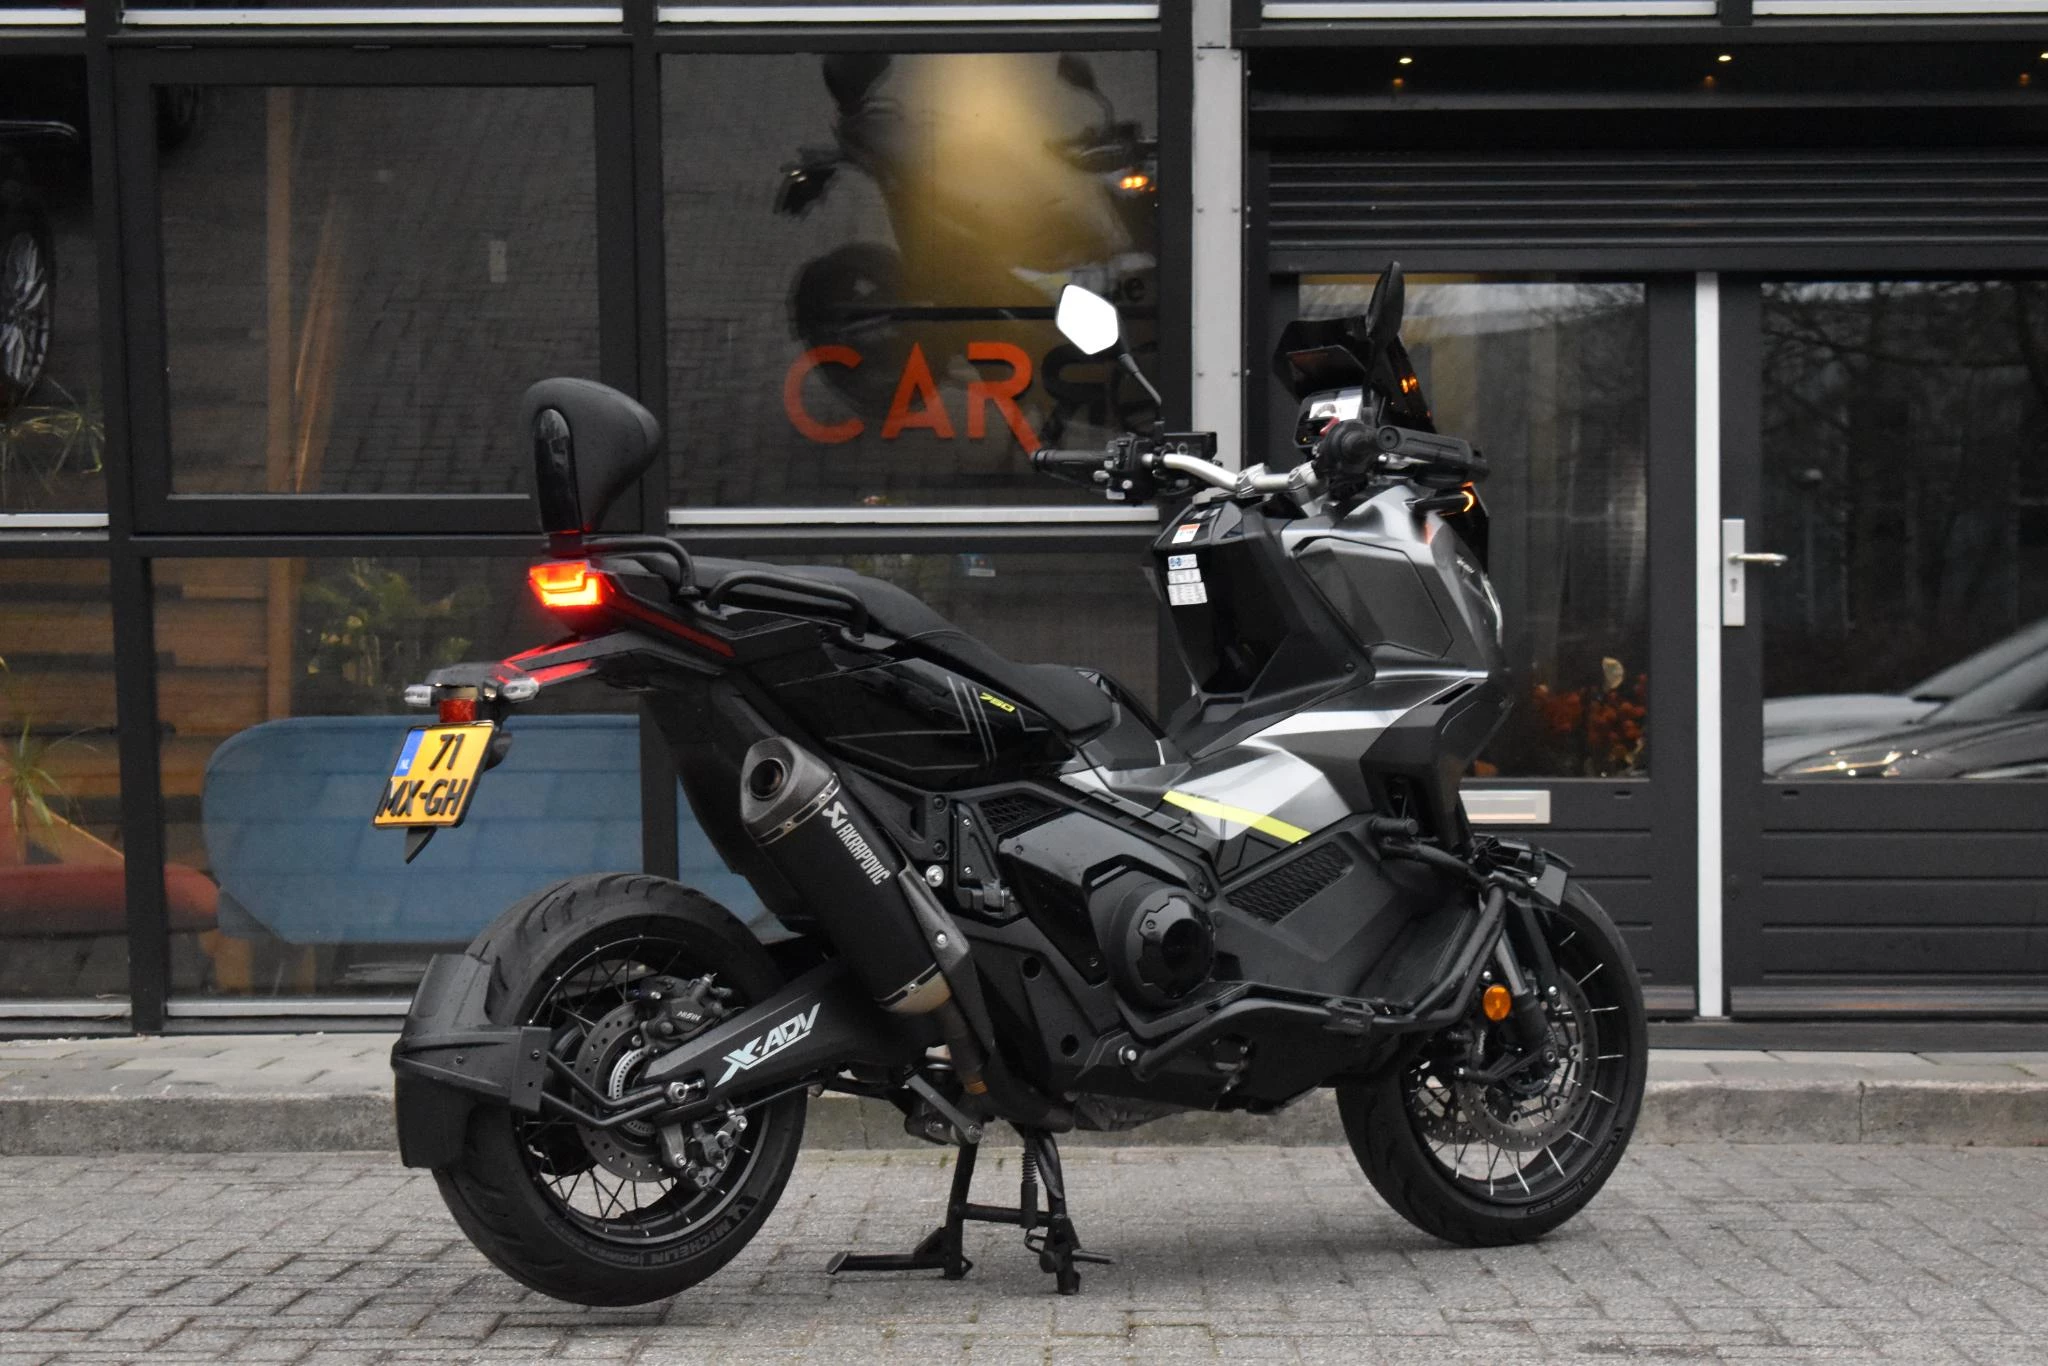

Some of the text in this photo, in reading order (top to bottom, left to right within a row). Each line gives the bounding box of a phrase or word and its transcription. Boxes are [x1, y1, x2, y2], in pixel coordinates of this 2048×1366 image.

[980, 692, 1016, 712] 750
[429, 733, 466, 771] 71
[377, 778, 469, 818] MX-GH
[714, 1002, 821, 1088] X-ADV
[651, 1222, 732, 1265] MICHELIN
